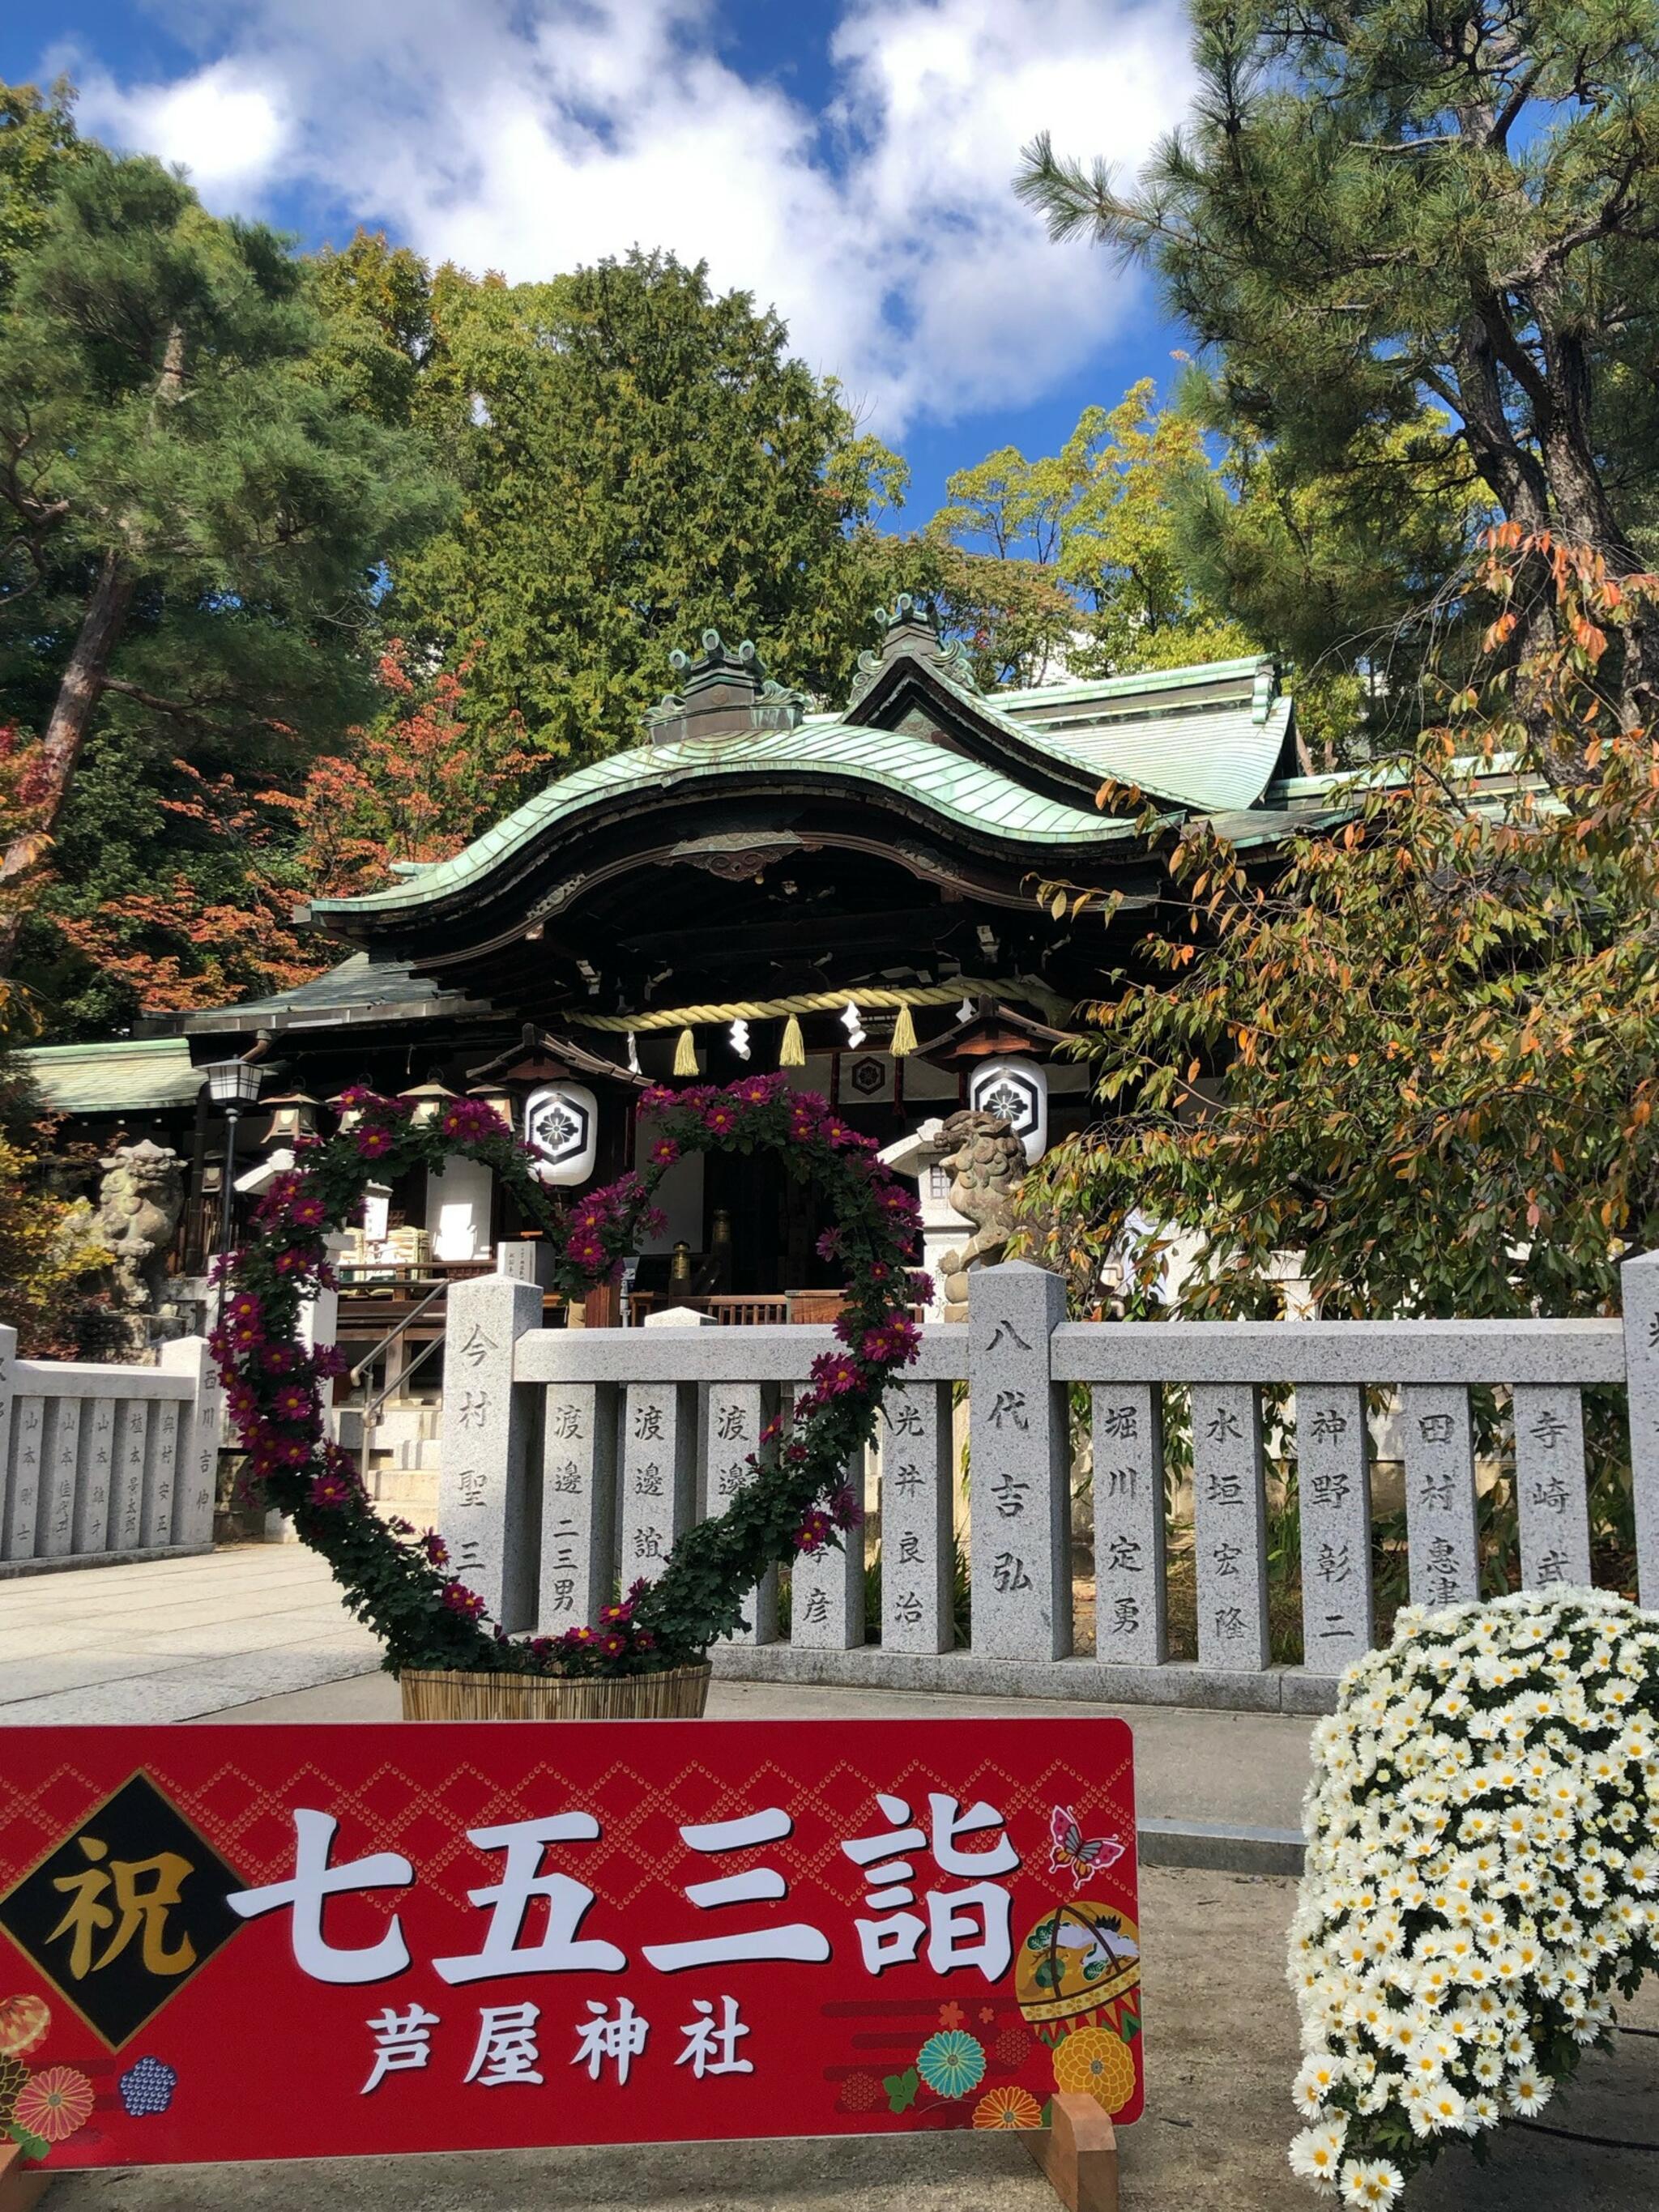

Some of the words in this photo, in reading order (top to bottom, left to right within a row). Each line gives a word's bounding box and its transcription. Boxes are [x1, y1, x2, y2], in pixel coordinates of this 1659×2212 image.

[455, 1323, 500, 1571] 今村聖三
[551, 1404, 585, 1612] 渡邊二三男
[894, 1405, 926, 1624] 光井良治
[984, 1319, 1034, 1593] 八代吉弘
[1105, 1405, 1143, 1635] 堀川定勇
[1205, 1407, 1252, 1640] 水垣宏隆
[1310, 1409, 1355, 1639] 神野彰二
[44, 1835, 199, 1981] 祝
[225, 1791, 1022, 1984] 七五三詣
[358, 1994, 755, 2096] 芦屋神社
